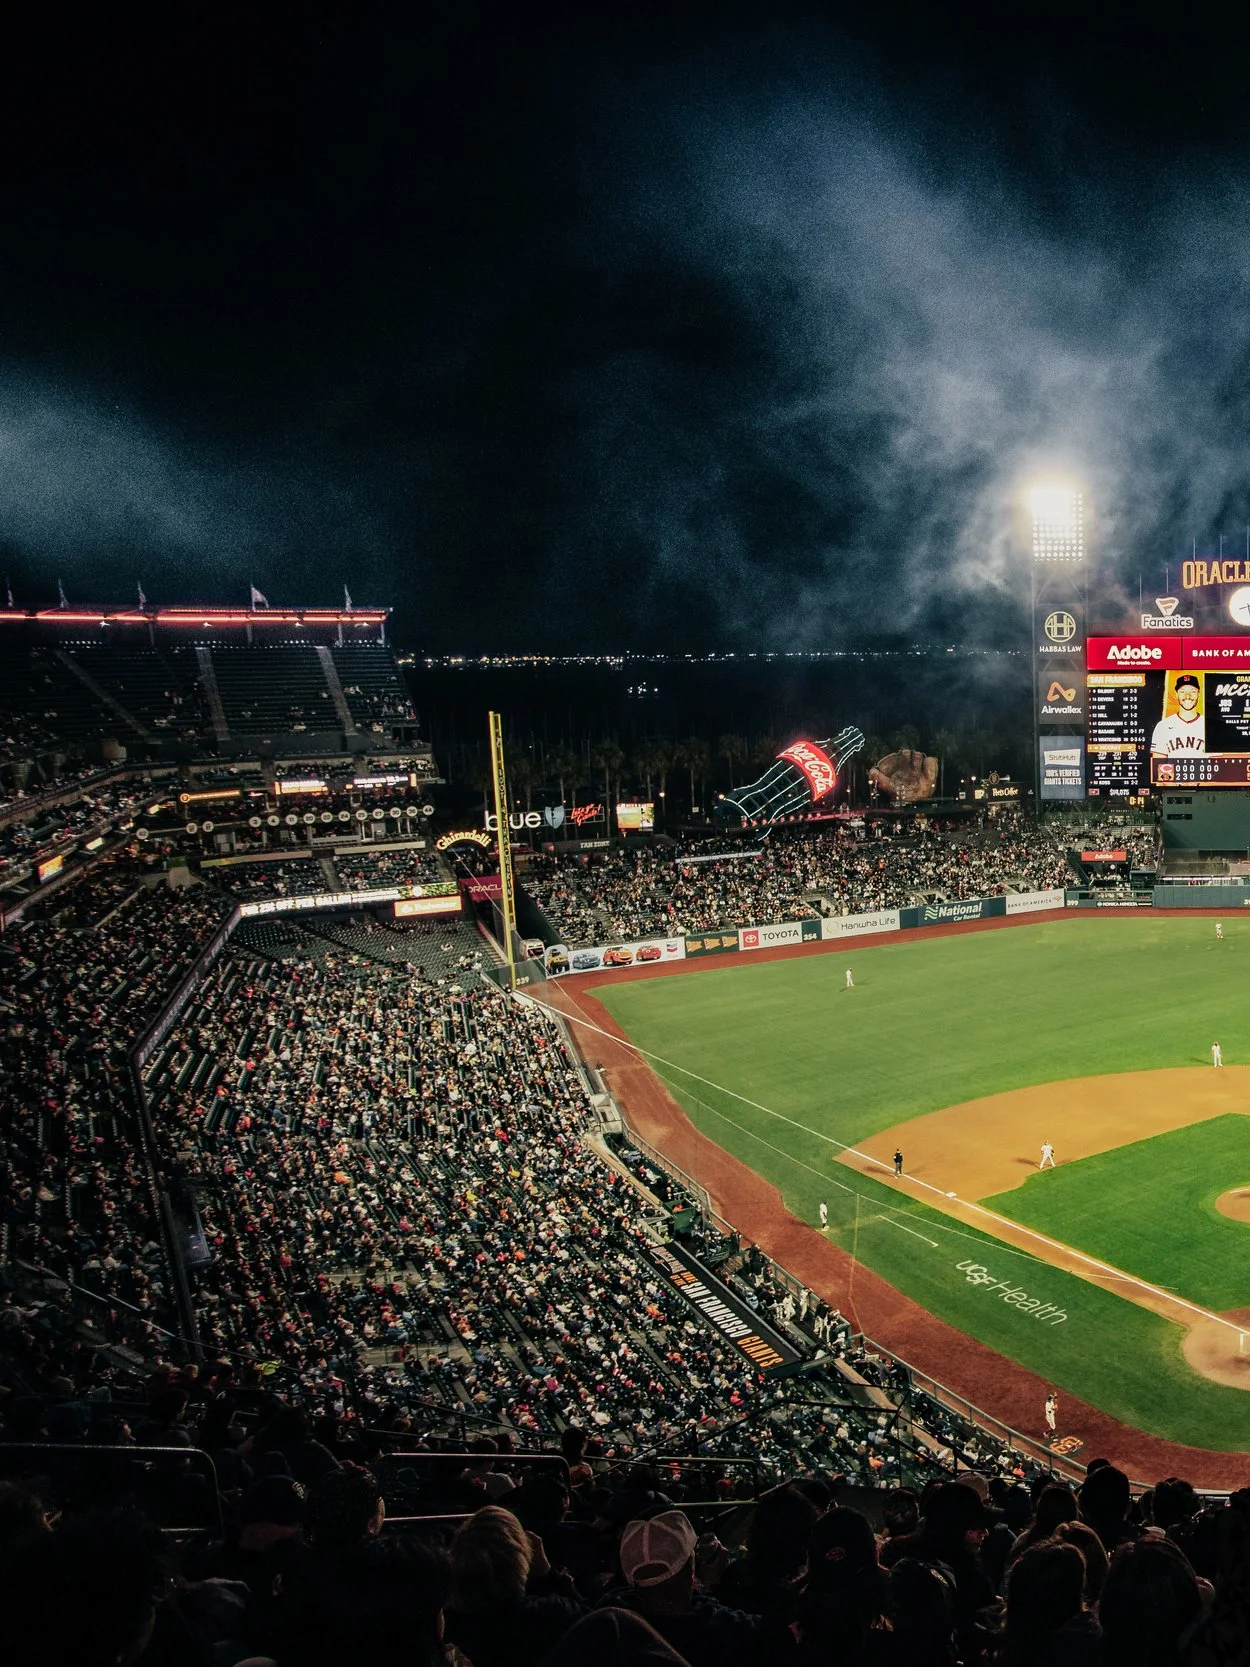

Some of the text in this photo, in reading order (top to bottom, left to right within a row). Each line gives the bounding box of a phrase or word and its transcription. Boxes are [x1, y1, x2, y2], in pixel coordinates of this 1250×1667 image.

[1142, 614, 1192, 628] Fanatics
[1107, 645, 1162, 660] Adobe
[1042, 706, 1082, 714] Airwallex
[780, 744, 834, 794] Coca-Cola
[1004, 787, 1019, 796] Coffee
[484, 810, 542, 831] bue
[437, 830, 492, 849] Ghirardelli
[468, 884, 502, 893] ORACL
[938, 902, 982, 918] National
[841, 917, 896, 931] Hanwha Life
[762, 929, 799, 940] TOYOTA
[516, 976, 529, 986] 339
[956, 1260, 1067, 1325] UCSF Health
[681, 1282, 784, 1368] SAN FRANCISCO GIANTS
